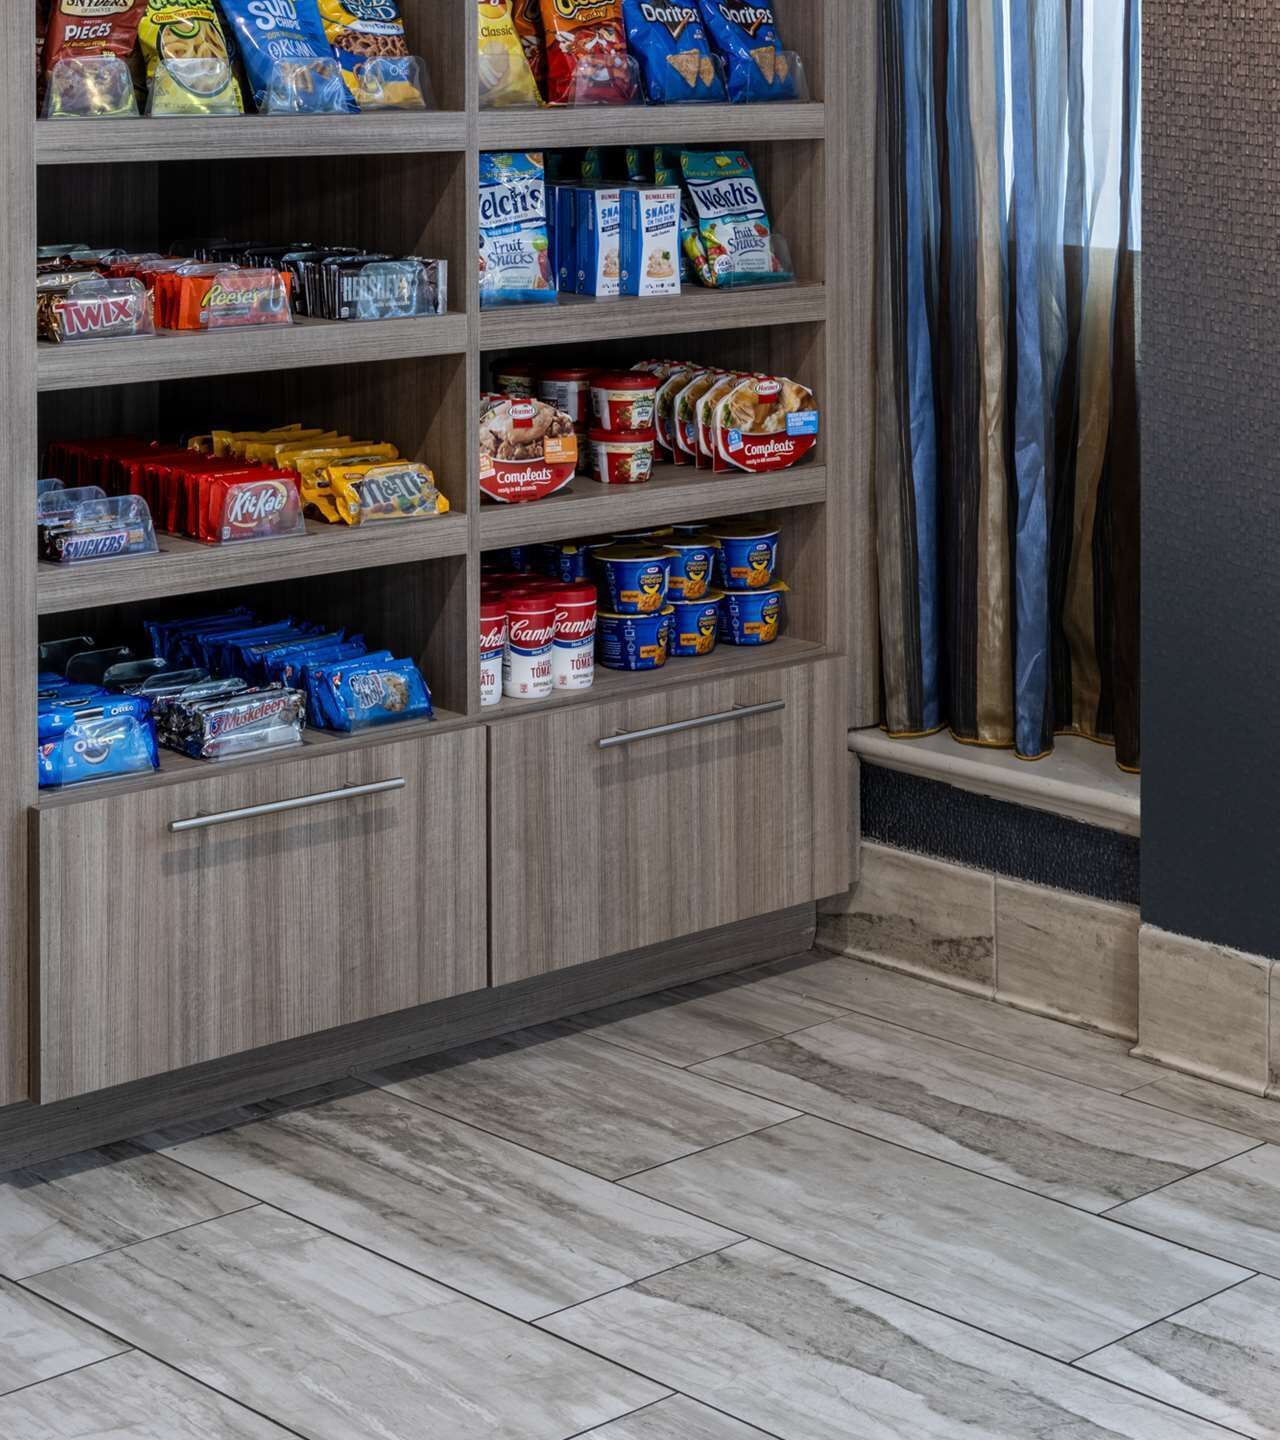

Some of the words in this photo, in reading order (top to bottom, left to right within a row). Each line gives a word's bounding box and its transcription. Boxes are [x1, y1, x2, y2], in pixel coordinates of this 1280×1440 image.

[640, 4, 700, 23] Doritos
[719, 4, 773, 23] Doritos
[64, 23, 112, 41] PIECES
[481, 25, 512, 37] Classic
[479, 184, 542, 220] elch's
[693, 183, 757, 211] Welch's
[601, 206, 619, 219] SNA
[645, 203, 675, 219] SNACK
[733, 225, 753, 241] Fruit
[493, 239, 523, 256] Fruit
[728, 234, 765, 255] Snacks
[488, 252, 534, 270] Snacks
[745, 440, 794, 456] Compleats
[497, 468, 551, 485] Compleats
[64, 535, 126, 559] SNICKERS
[531, 666, 551, 679] TOMA
[111, 705, 134, 715] OREO
[211, 713, 223, 736] 3
